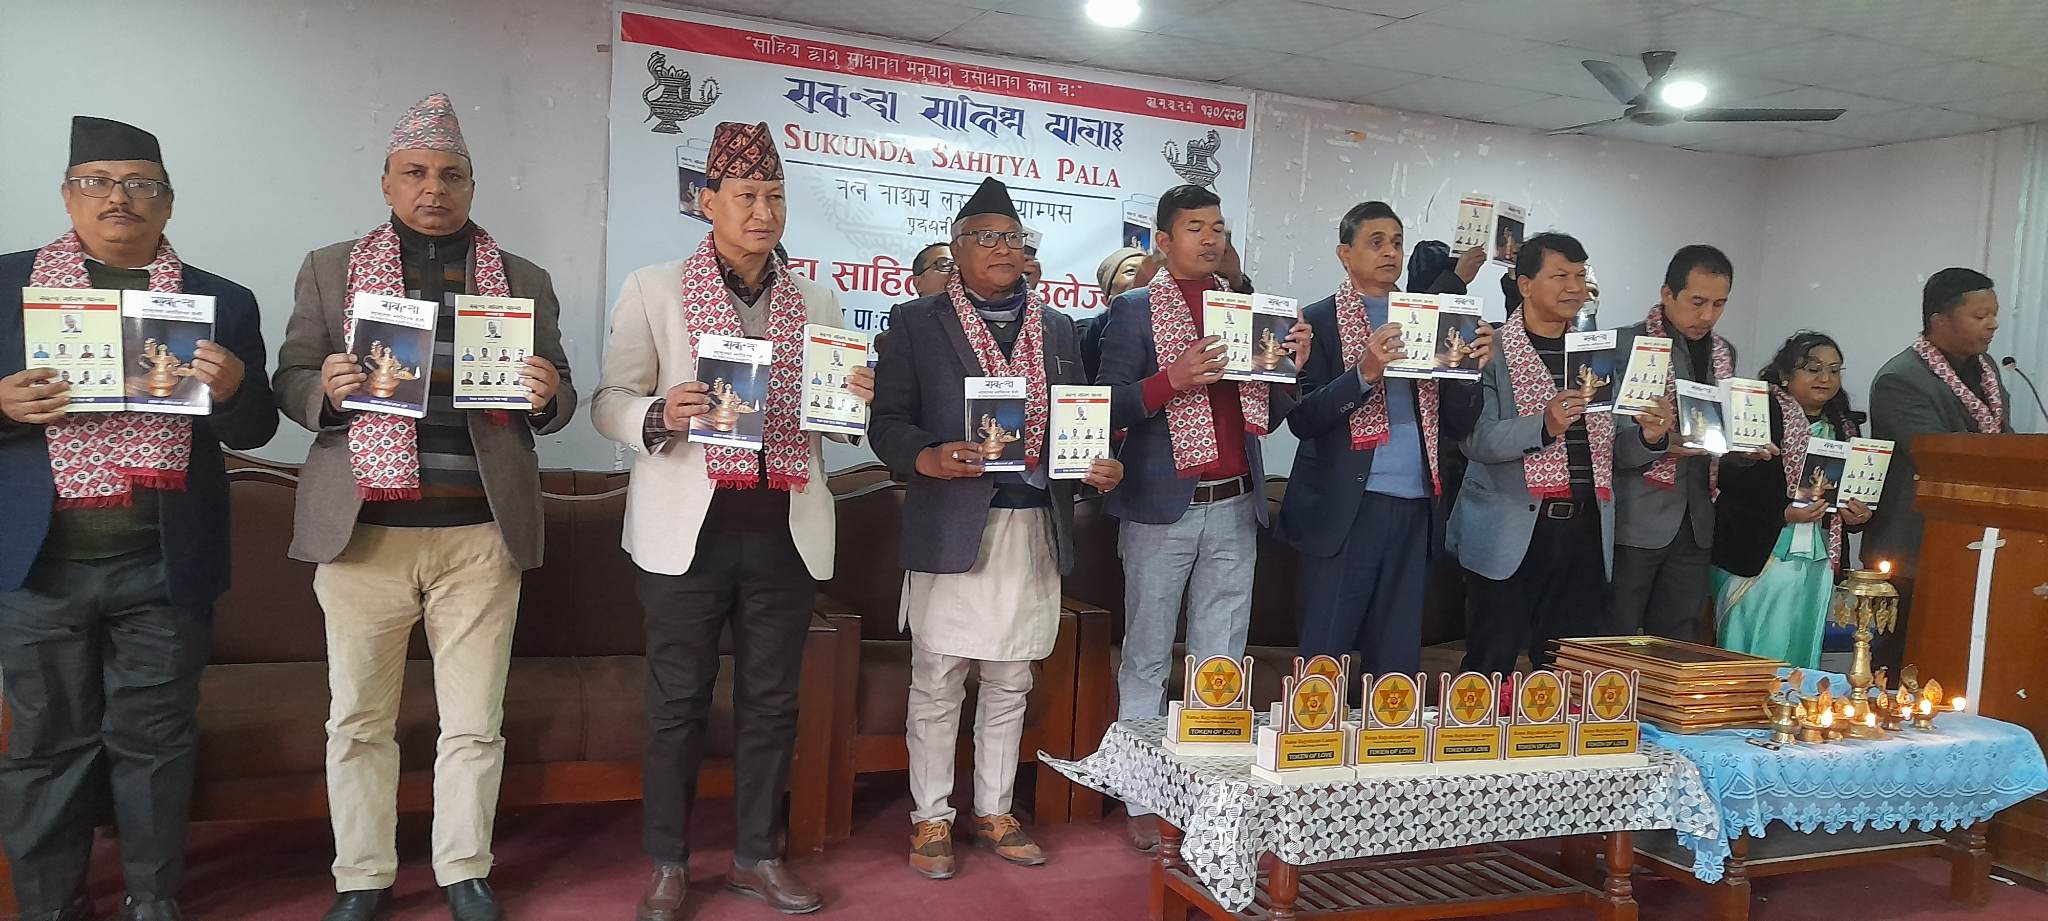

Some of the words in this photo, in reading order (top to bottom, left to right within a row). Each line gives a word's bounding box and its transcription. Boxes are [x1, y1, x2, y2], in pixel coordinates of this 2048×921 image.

[784, 123, 915, 165] SUKUNDA
[932, 141, 1041, 179] SAHITYA
[1056, 158, 1122, 189] PALA
